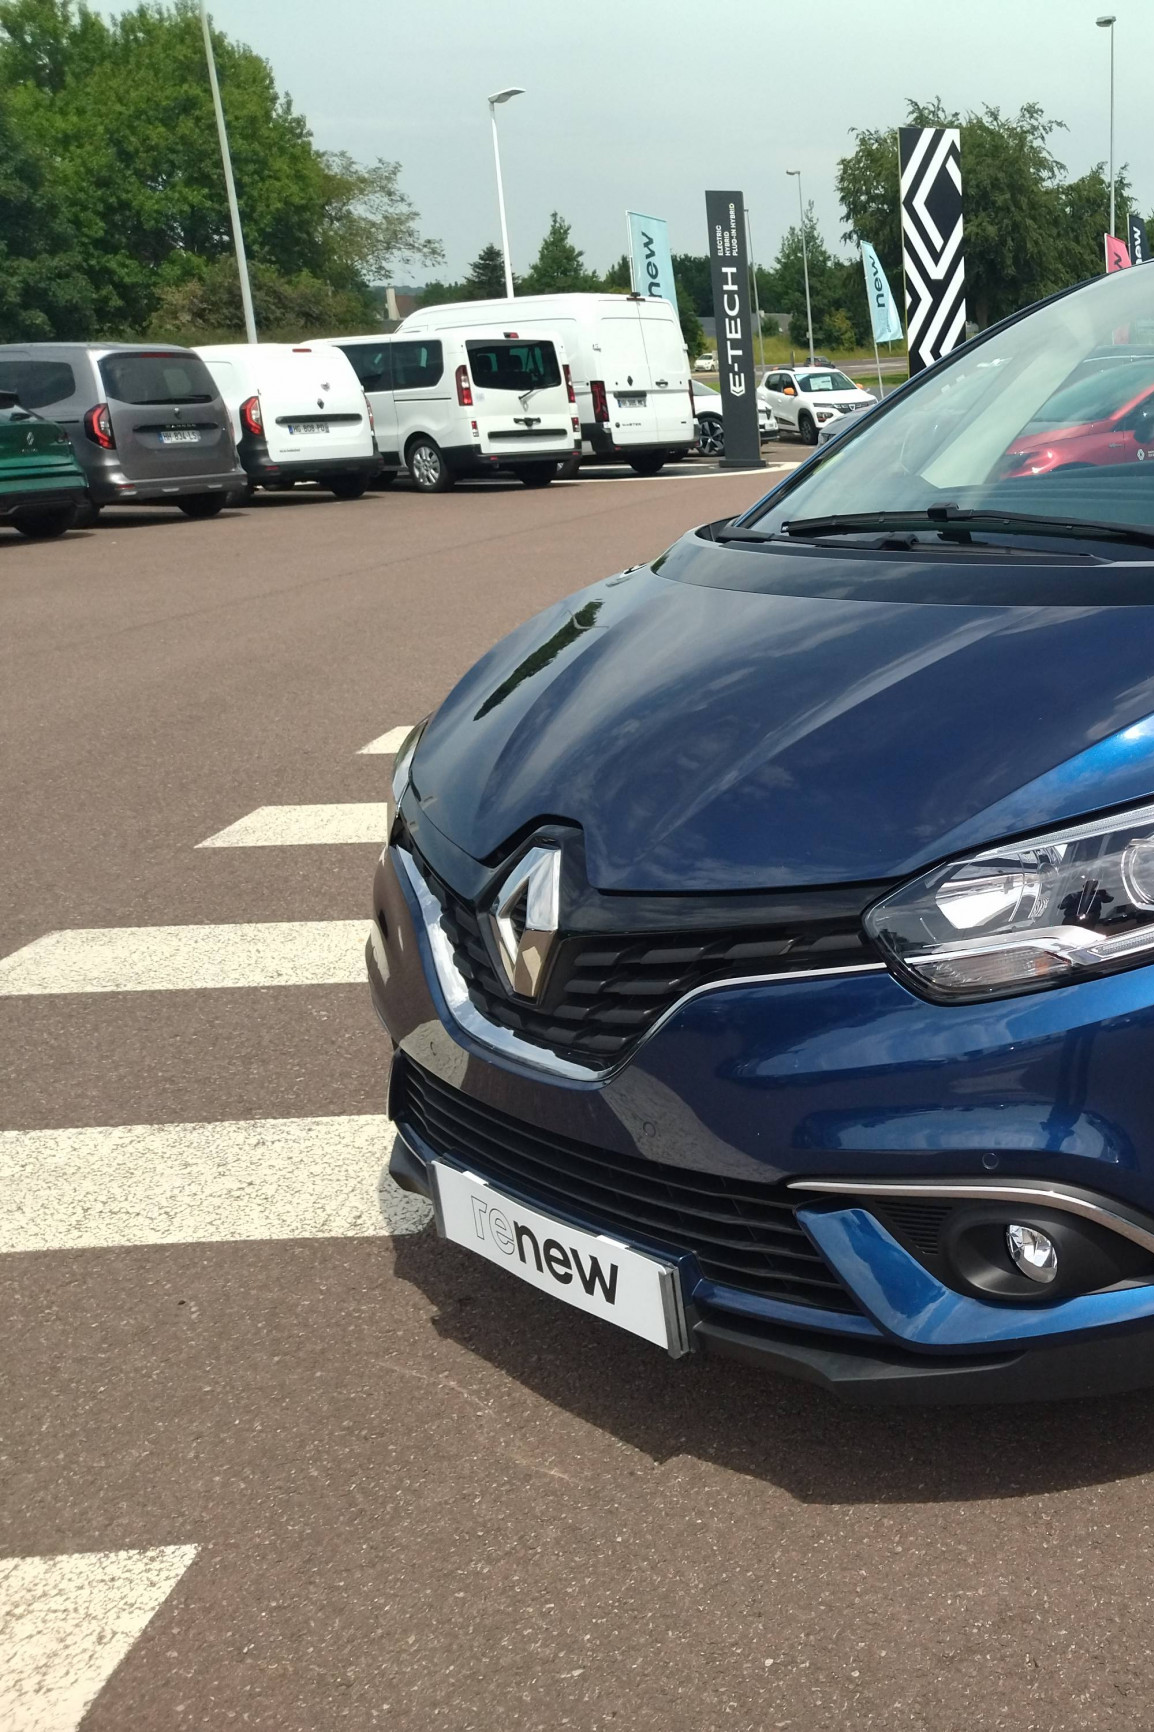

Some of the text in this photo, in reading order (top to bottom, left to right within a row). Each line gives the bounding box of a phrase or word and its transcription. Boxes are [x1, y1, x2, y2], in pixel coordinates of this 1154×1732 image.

[715, 225, 724, 256] ELECTRIC
[723, 231, 732, 256] HYBRID
[728, 203, 739, 256] PLUG-IN HYBRID
[721, 267, 746, 397] E-TECH
[471, 1195, 618, 1305] renew
